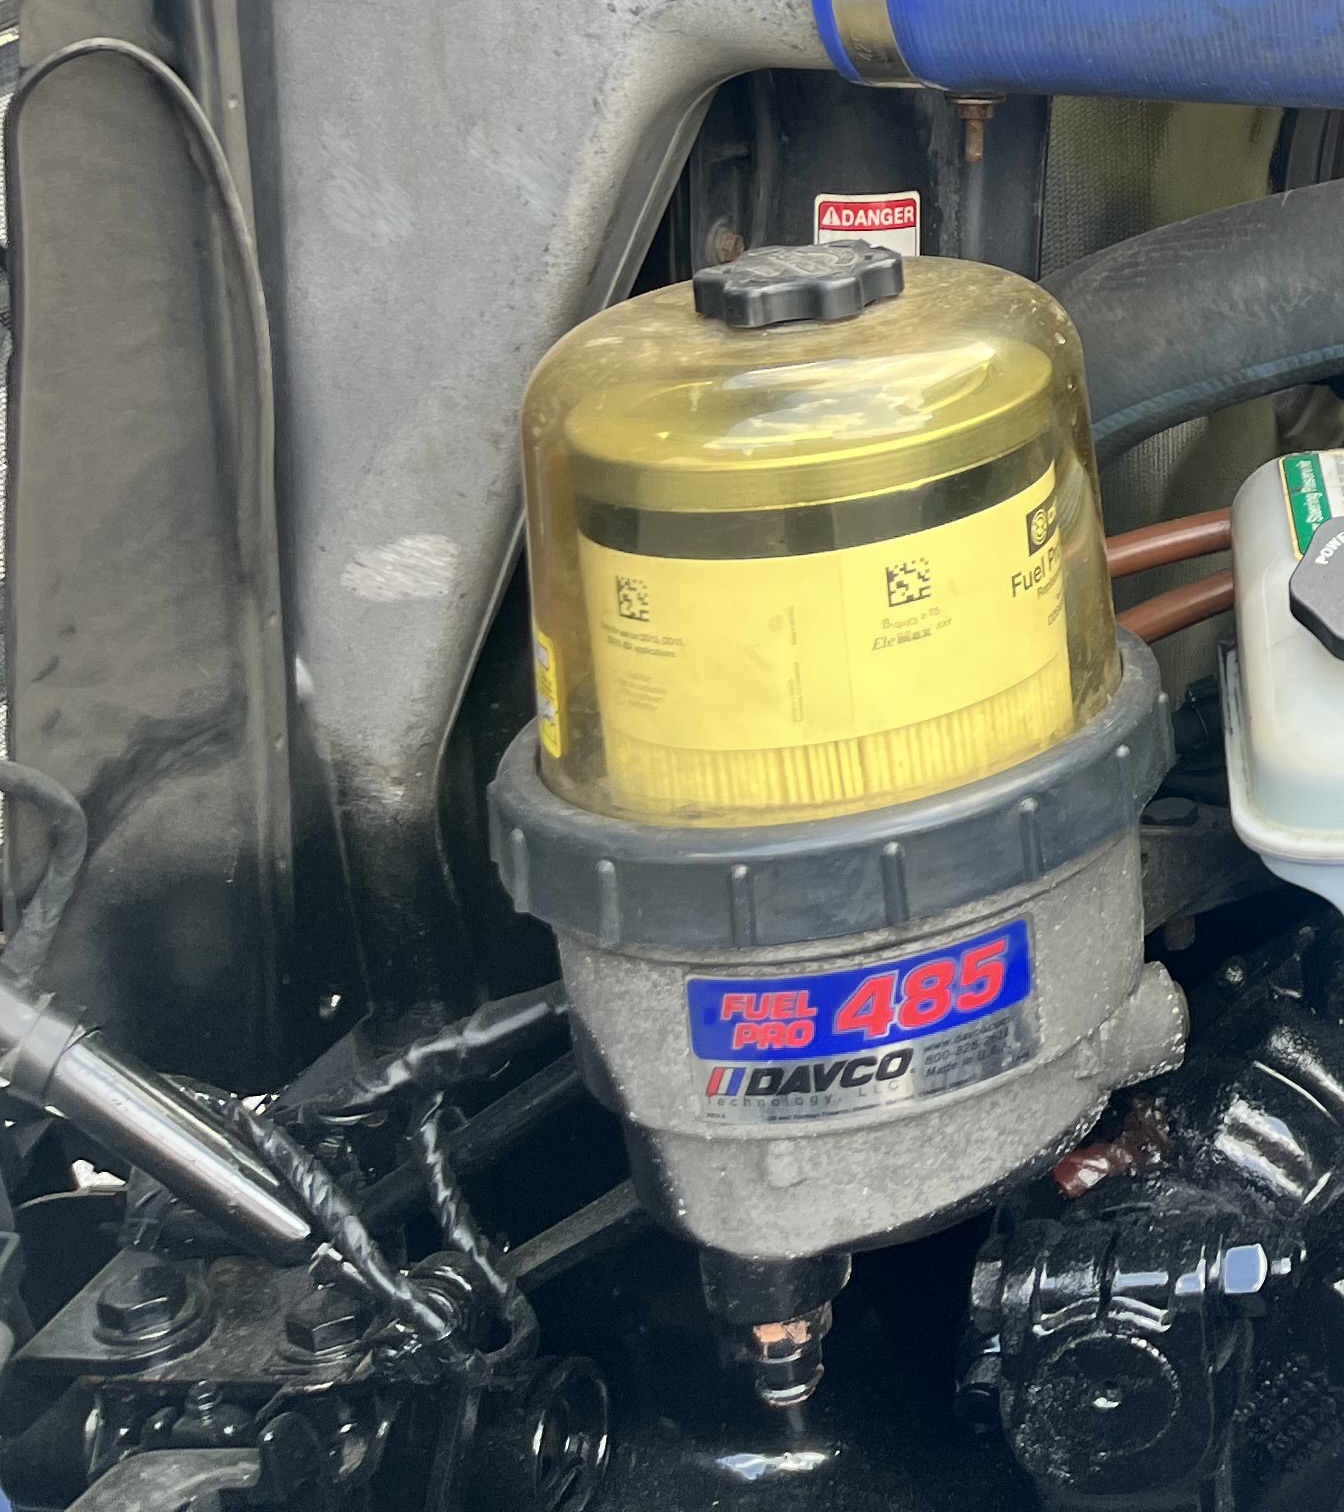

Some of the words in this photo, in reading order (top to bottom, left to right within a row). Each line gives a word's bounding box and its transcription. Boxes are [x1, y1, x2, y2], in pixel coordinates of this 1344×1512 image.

[841, 205, 915, 227] DANGER
[1010, 555, 1046, 598] Fuel
[720, 989, 818, 1021] FUEL
[835, 938, 1008, 1040] 485
[731, 1019, 815, 1052] PRO
[744, 1047, 915, 1098] DAVCO
[706, 1092, 842, 1109] Technology,
[858, 1079, 900, 1098] LLC
